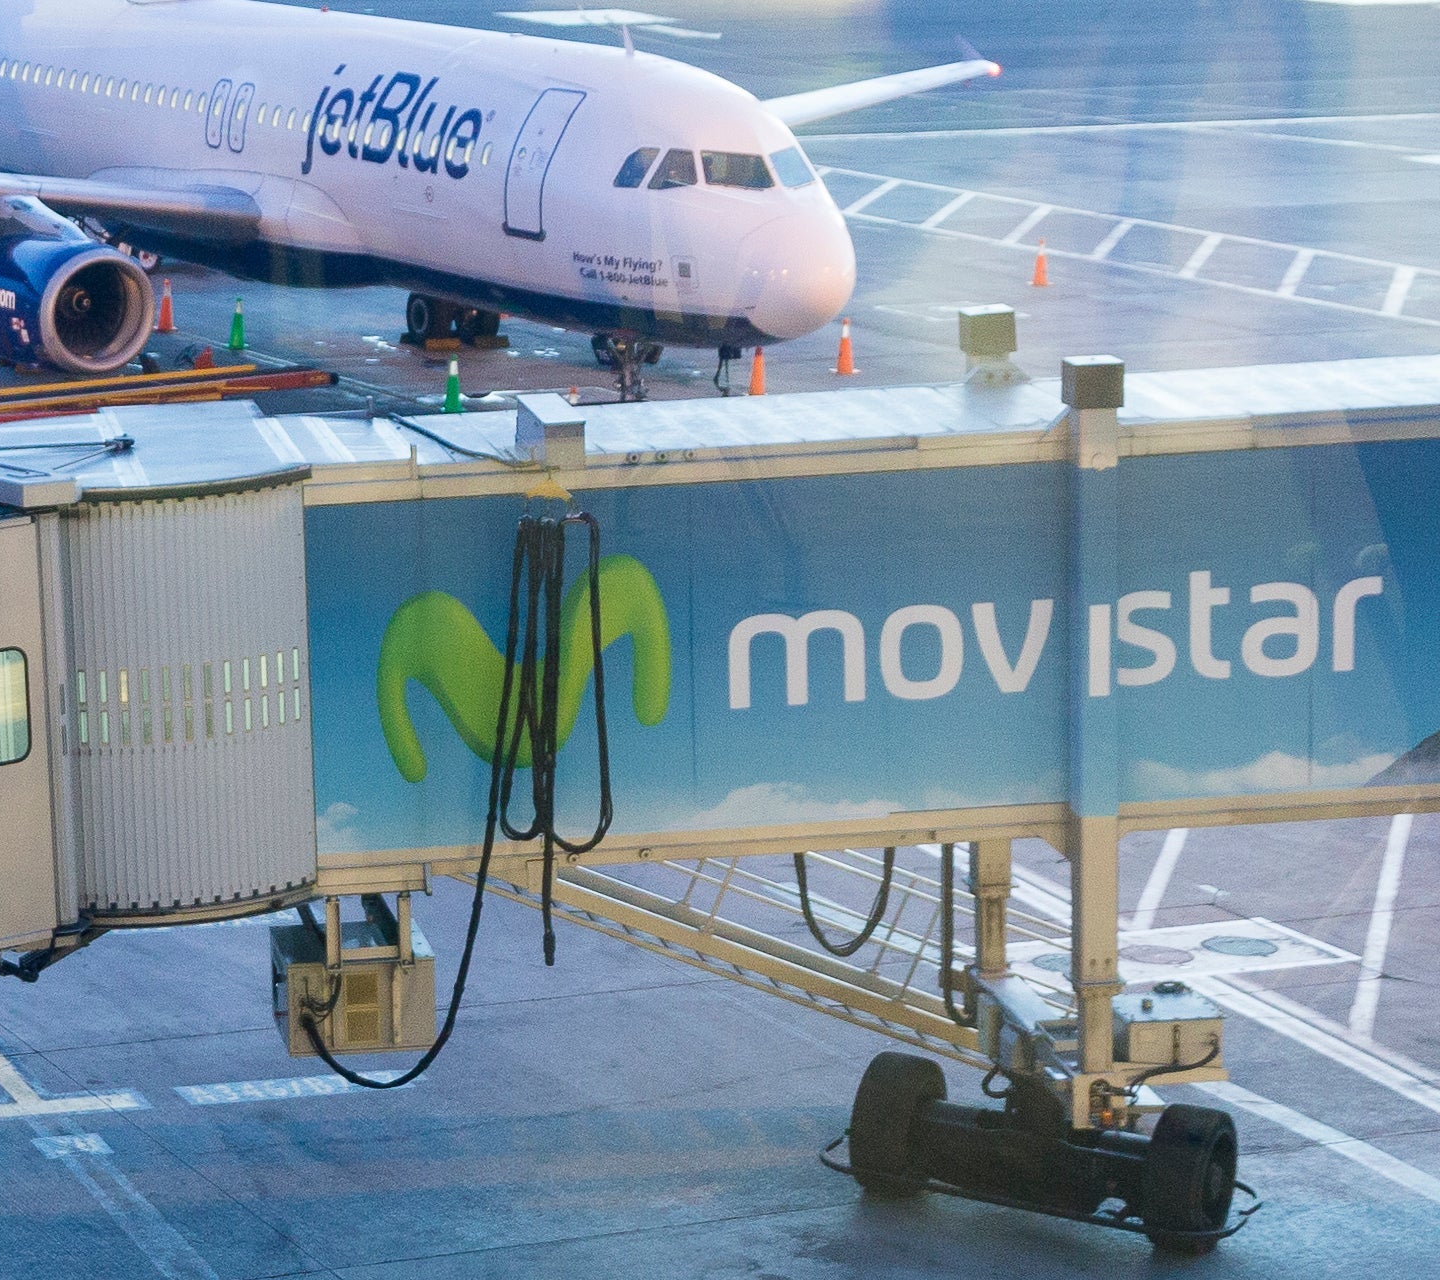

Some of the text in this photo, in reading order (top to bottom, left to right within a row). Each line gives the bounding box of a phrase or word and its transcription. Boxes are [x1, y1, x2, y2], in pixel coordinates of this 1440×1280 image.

[301, 63, 482, 179] jetBlue
[604, 255, 621, 270] My
[623, 257, 663, 273] Flying?
[727, 570, 1383, 710] movistar
